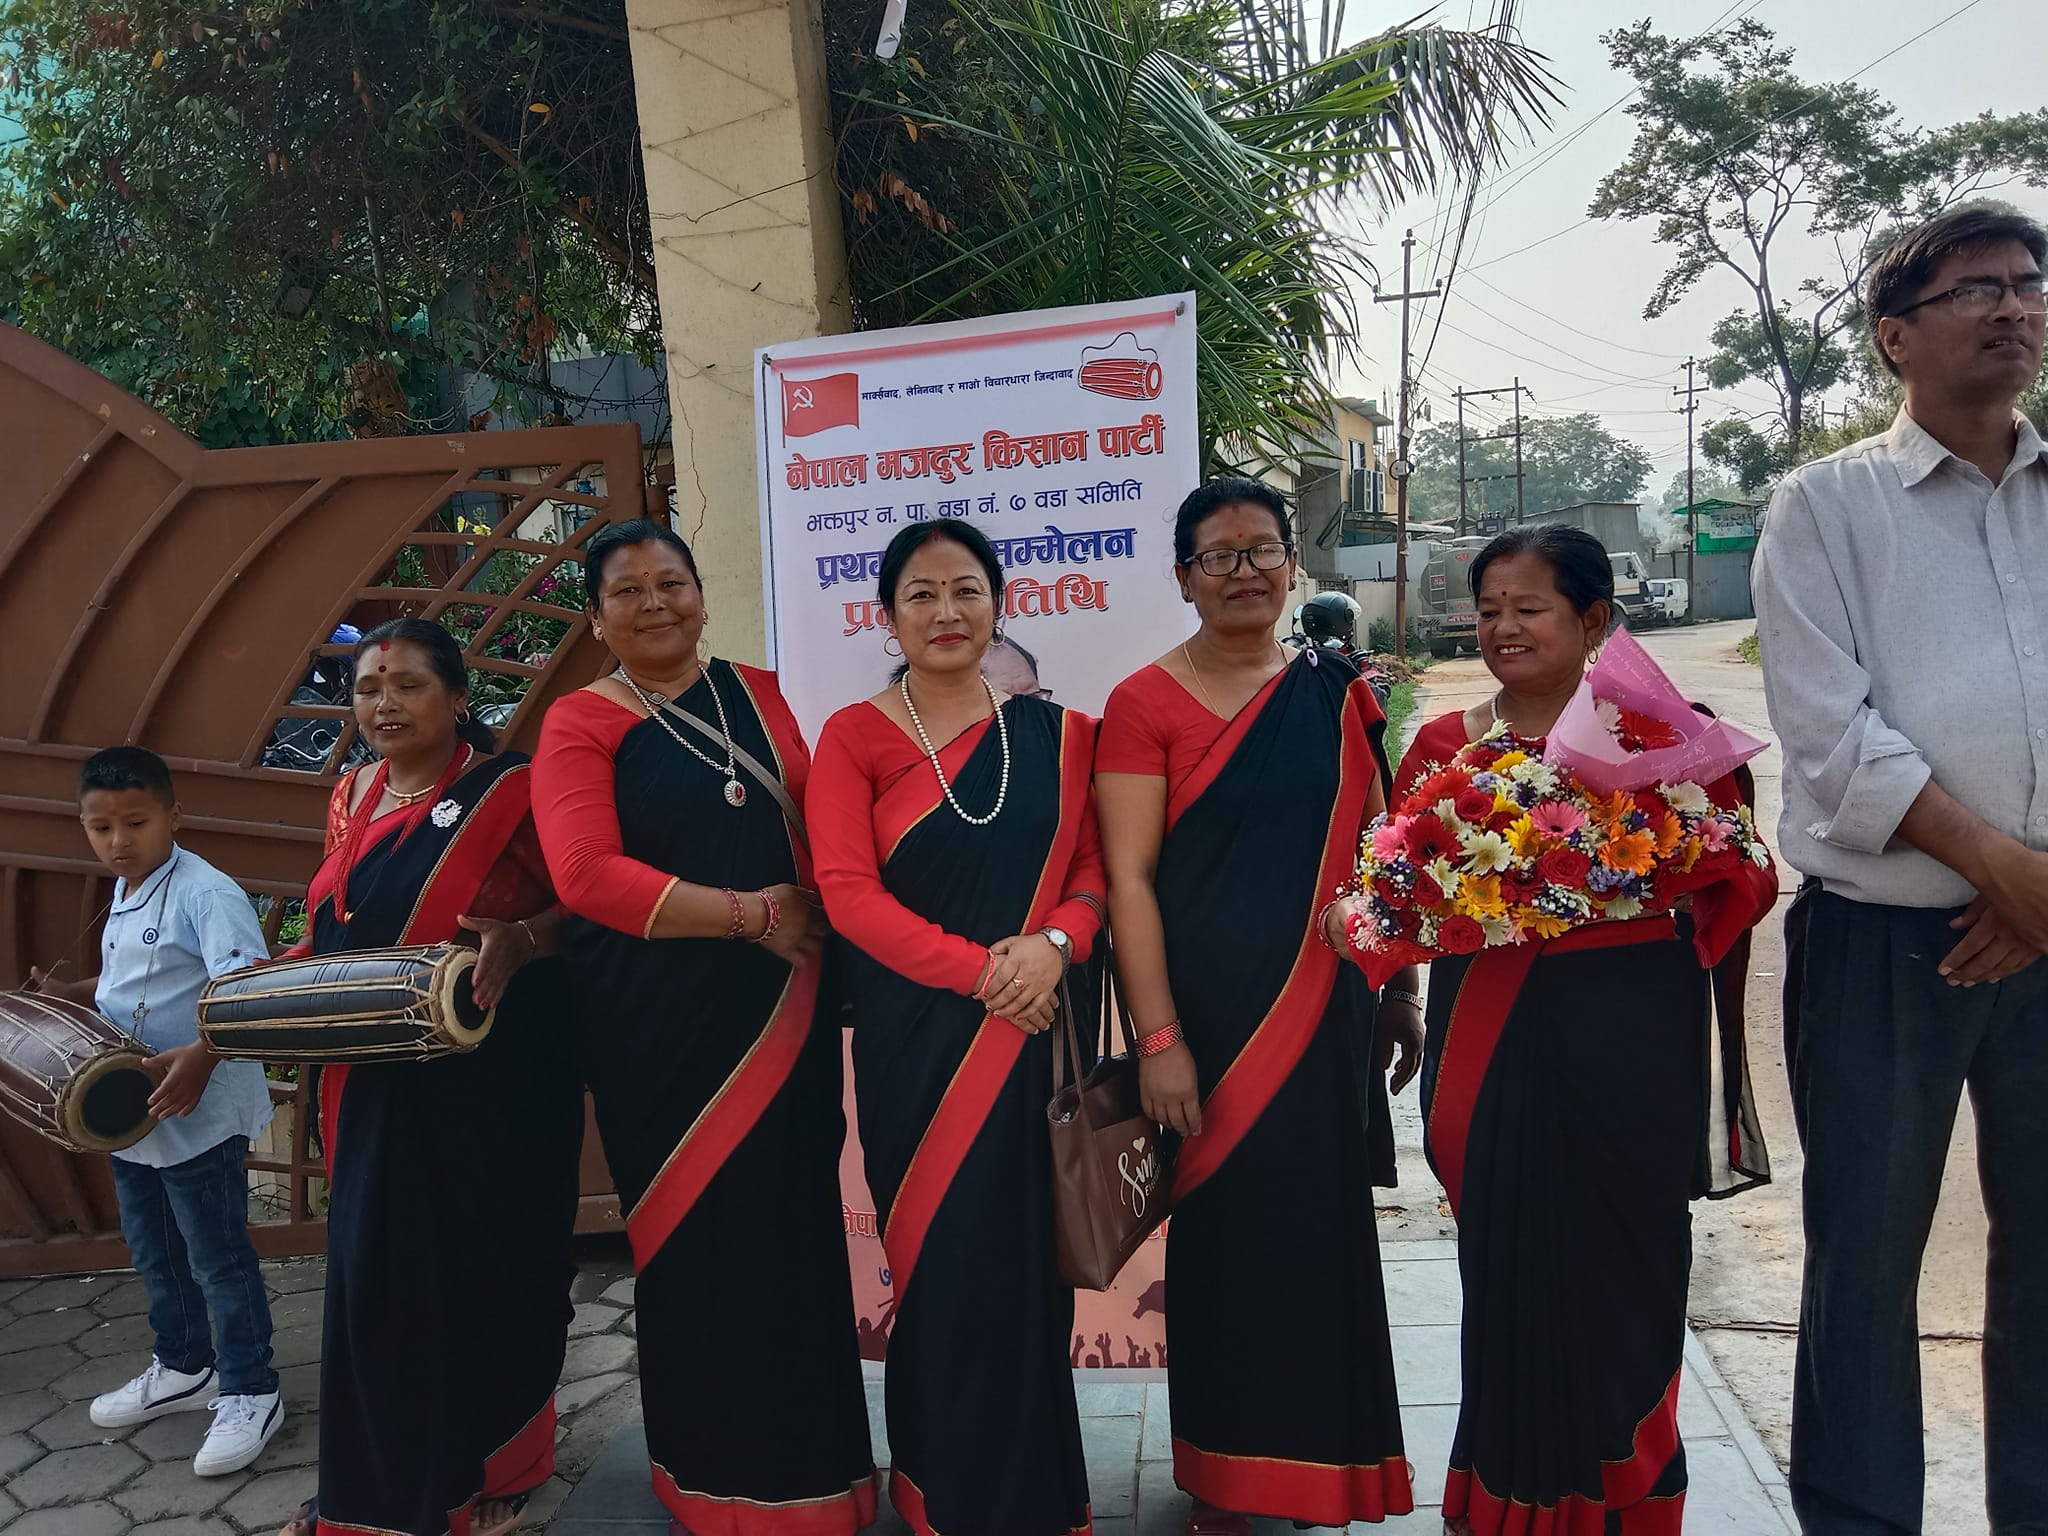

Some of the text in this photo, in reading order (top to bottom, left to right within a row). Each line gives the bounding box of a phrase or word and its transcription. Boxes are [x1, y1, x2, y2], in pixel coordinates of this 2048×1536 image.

[947, 382, 955, 393] र
[958, 378, 981, 391] माओ
[984, 374, 1031, 388] विचारधारा
[1034, 368, 1074, 383] जिन्दावाद
[785, 414, 1166, 491] नेपाल मजदुर किसान पार्टी
[807, 479, 1143, 534] भक्तपुर न. पा. वडा नं. ७ वडा समिति
[994, 573, 1110, 619] तिथि
